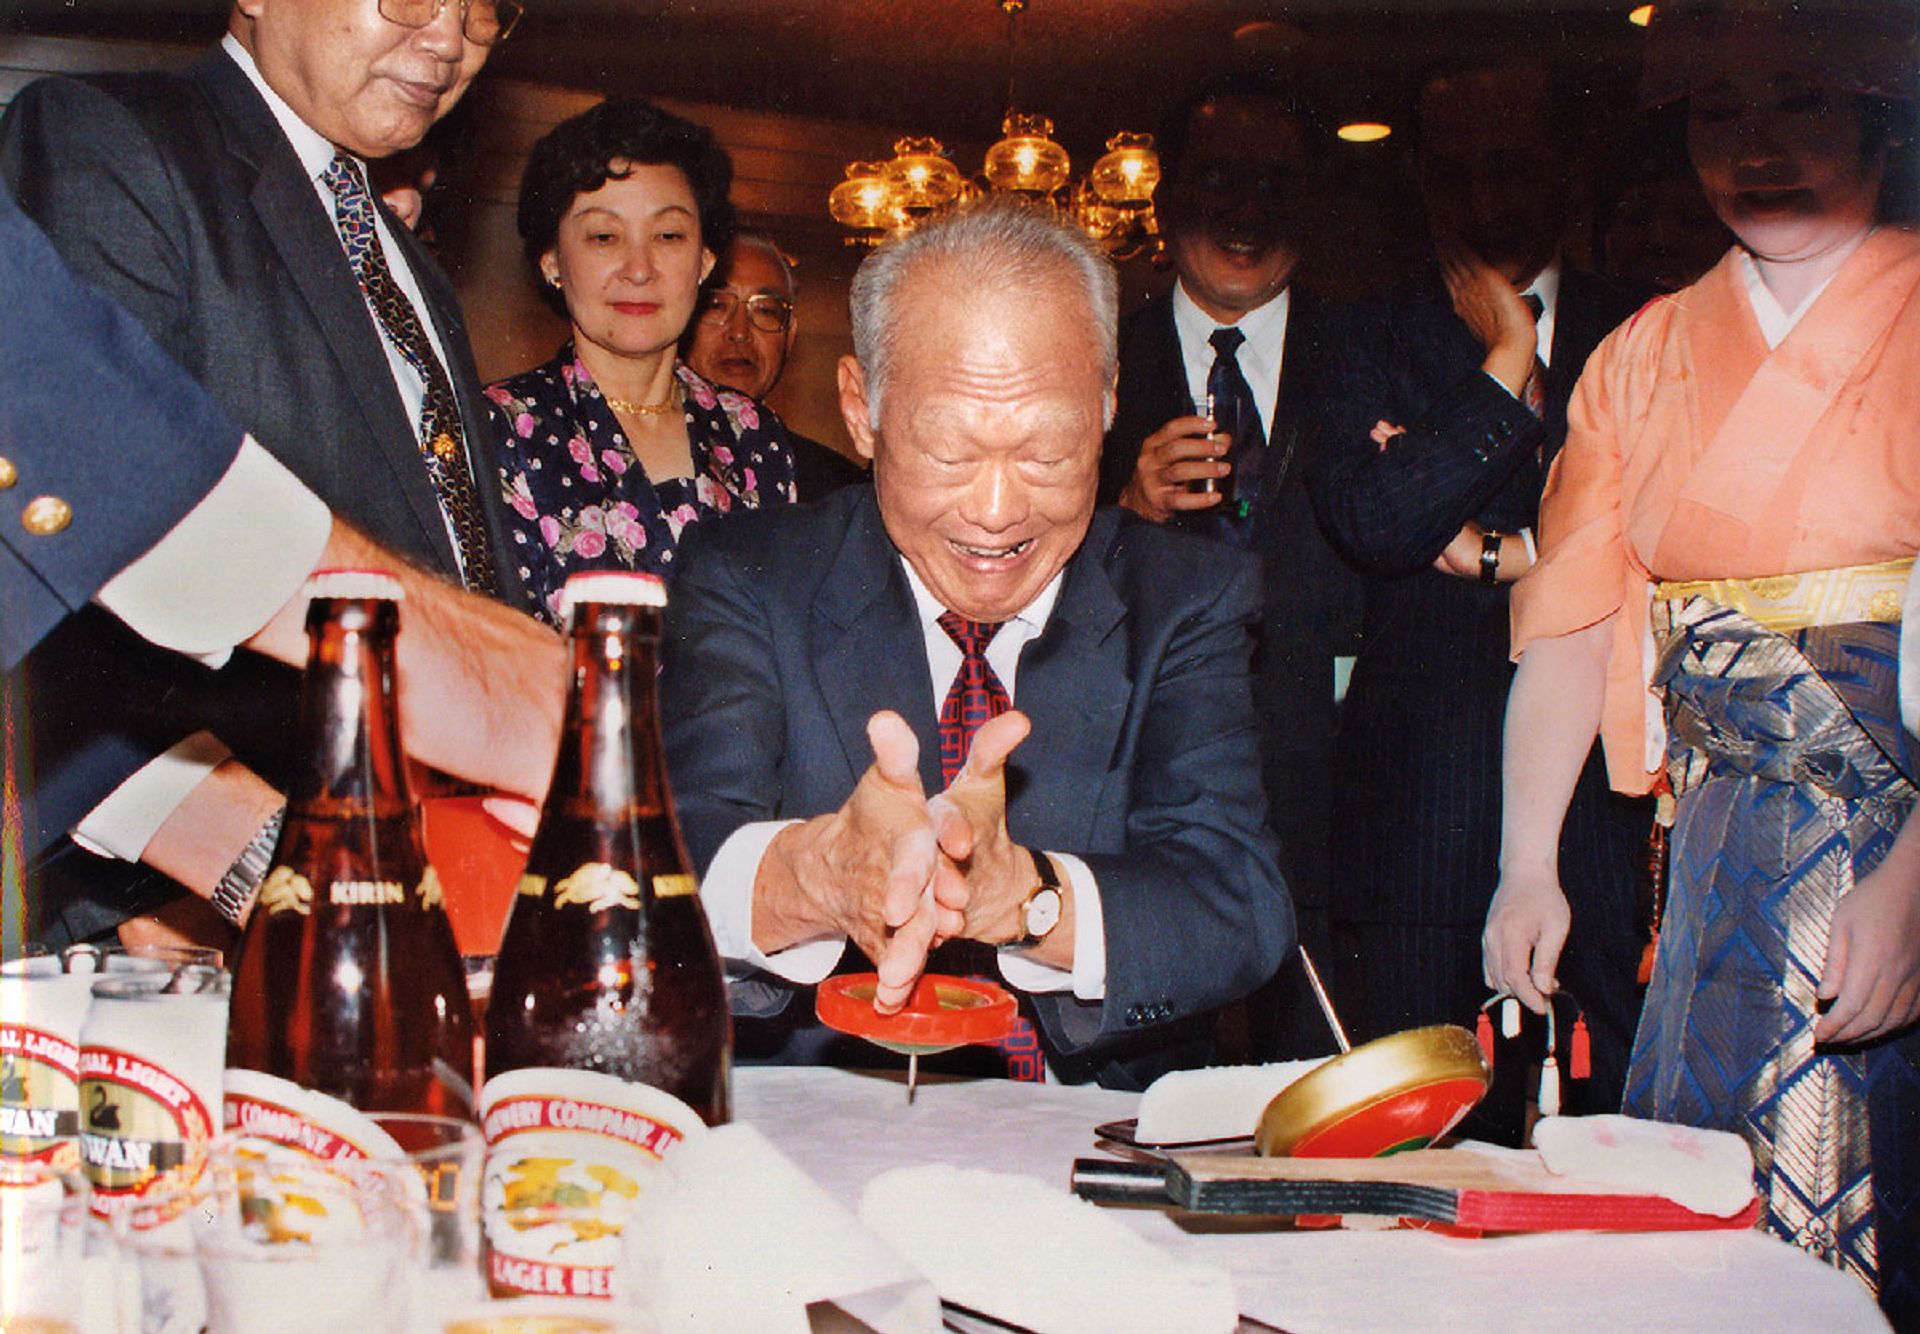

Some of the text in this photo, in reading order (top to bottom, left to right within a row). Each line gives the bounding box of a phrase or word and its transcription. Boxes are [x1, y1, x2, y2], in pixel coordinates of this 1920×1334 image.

[329, 881, 404, 904] KIRIN
[0, 1109, 57, 1137] WAN
[493, 1254, 566, 1294] LAGER
